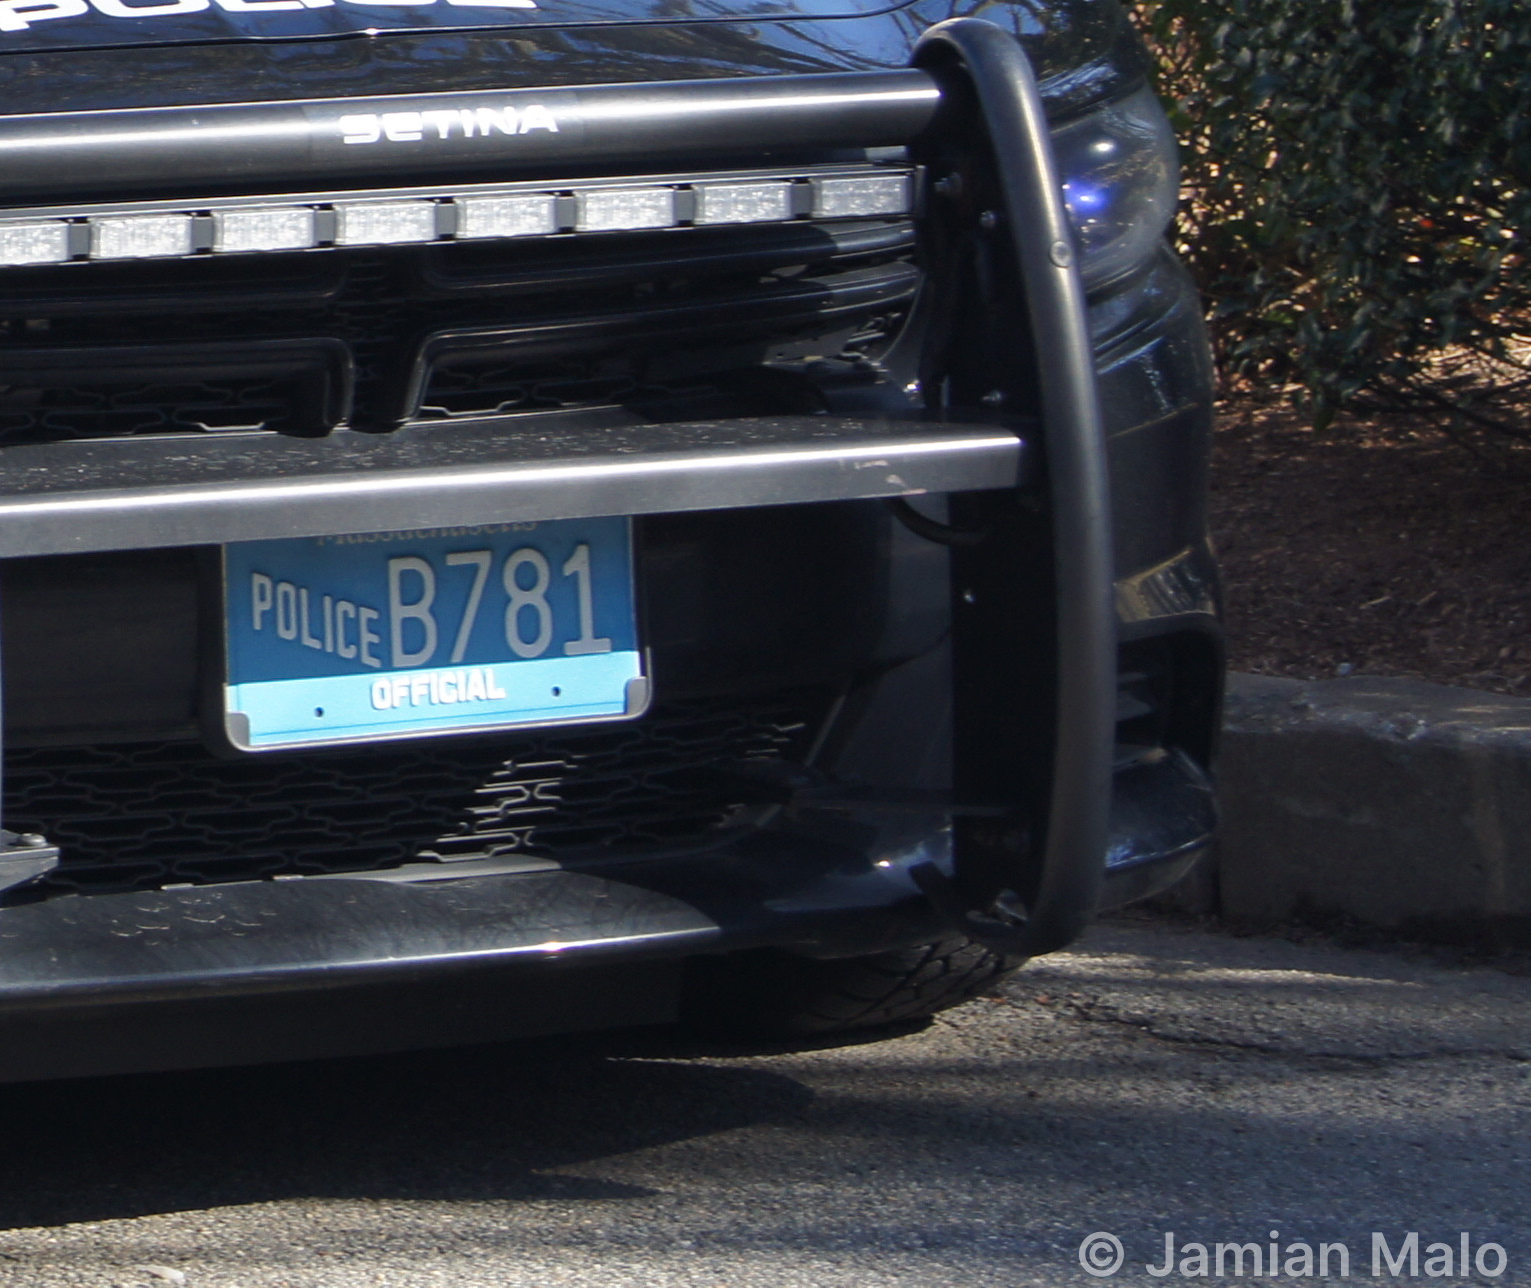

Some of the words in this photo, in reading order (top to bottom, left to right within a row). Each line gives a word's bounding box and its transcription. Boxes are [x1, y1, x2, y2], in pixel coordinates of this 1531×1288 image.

[339, 103, 559, 145] SETINA
[251, 571, 382, 669] POLICE
[388, 544, 612, 669] B781
[371, 667, 507, 711] OFFICIAL
